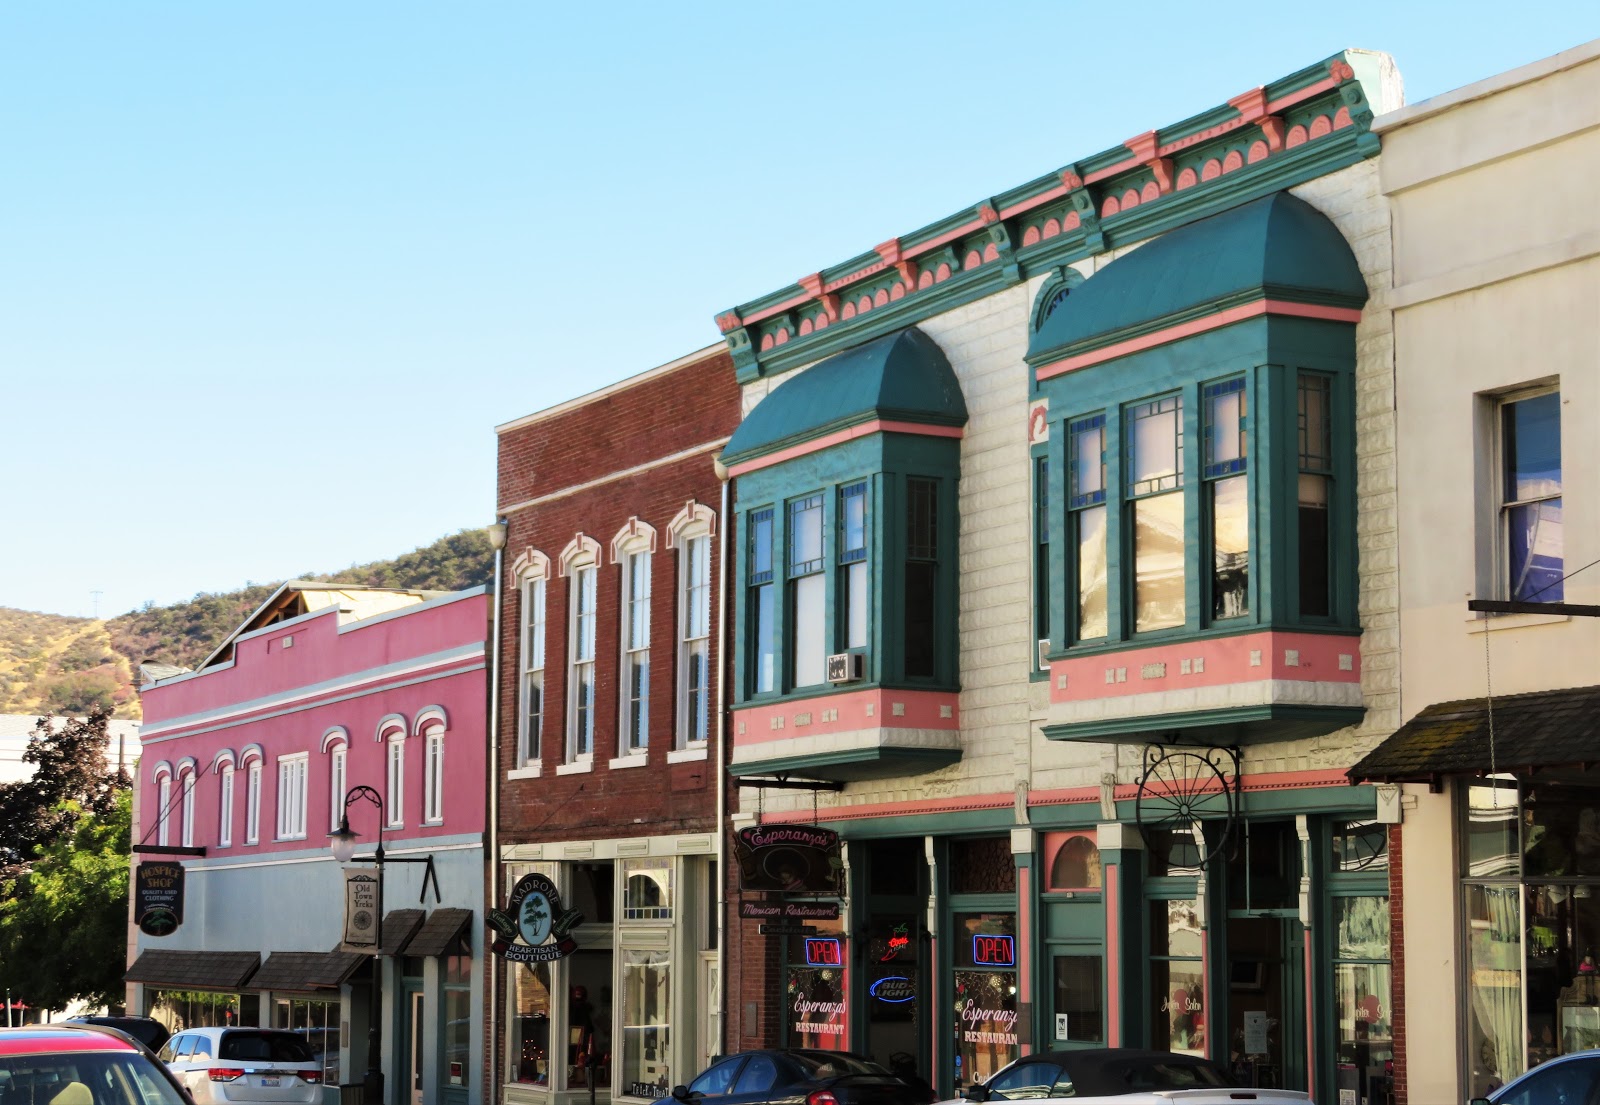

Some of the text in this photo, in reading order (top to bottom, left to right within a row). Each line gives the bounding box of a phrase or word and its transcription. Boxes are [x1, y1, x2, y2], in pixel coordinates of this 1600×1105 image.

[751, 827, 829, 846] Esperanza's
[141, 866, 180, 879] HOSPICE
[147, 878, 173, 888] SHOP
[355, 884, 371, 893] Old
[354, 891, 373, 900] Town
[512, 879, 559, 905] MADRONE
[354, 899, 373, 908] Yreka
[743, 903, 837, 917] Mexican Restaurant
[492, 911, 513, 933] Vintage
[504, 950, 563, 961] BOUTIQUE
[509, 944, 558, 954] HEARTISAN
[808, 942, 838, 963] OPEN
[976, 938, 1012, 962] OPEN
[881, 981, 909, 990] BUD
[876, 989, 913, 997] LIGHT
[794, 991, 846, 1022] Esperanza's
[962, 998, 1018, 1032] Esperanz
[795, 1021, 845, 1035] RESTAURANT
[964, 1031, 1018, 1045] RESTAURAN
